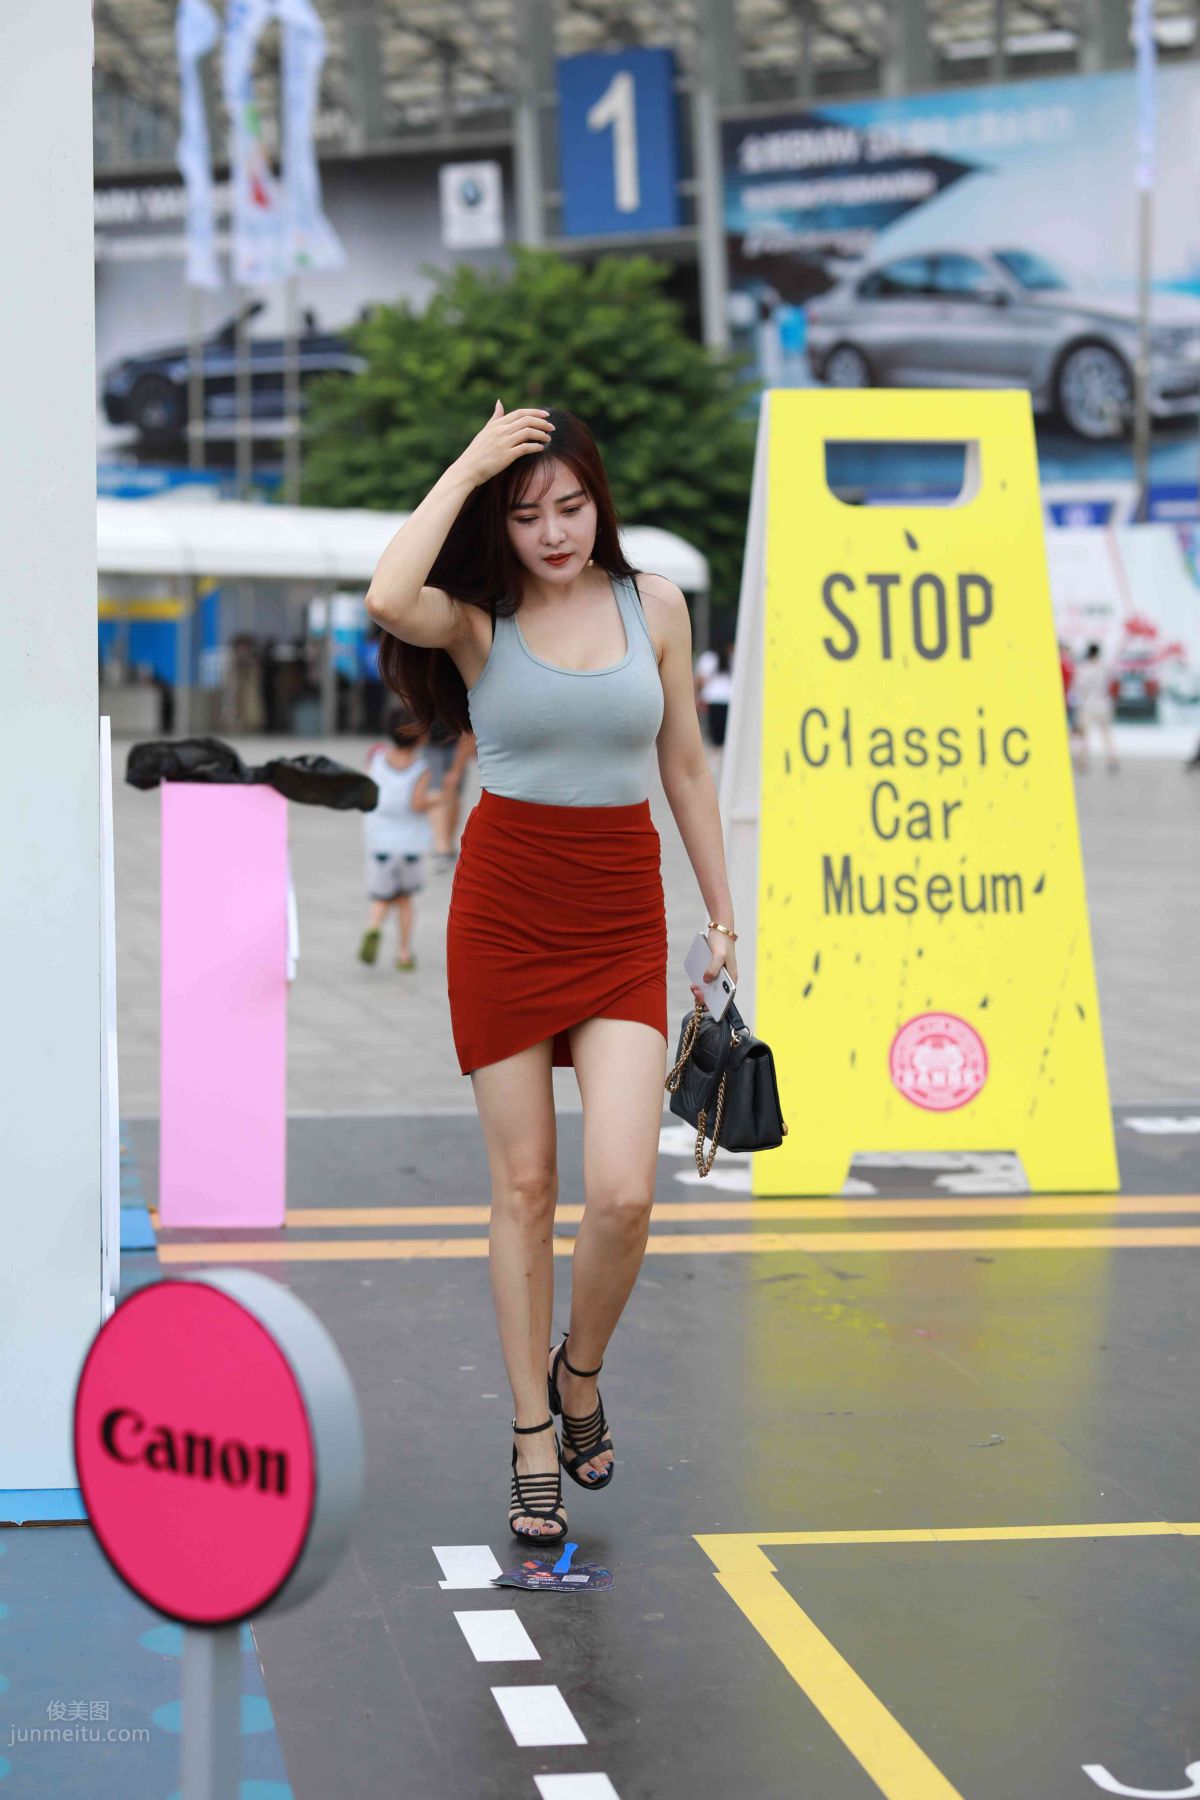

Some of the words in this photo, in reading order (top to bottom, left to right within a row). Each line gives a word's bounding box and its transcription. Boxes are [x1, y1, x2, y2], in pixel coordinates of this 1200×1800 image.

[587, 70, 640, 214] 1
[822, 572, 994, 661] STOP
[800, 707, 1030, 769] Classic
[870, 780, 963, 841] Car
[822, 854, 1025, 915] Museum
[99, 1405, 289, 1498] Canon
